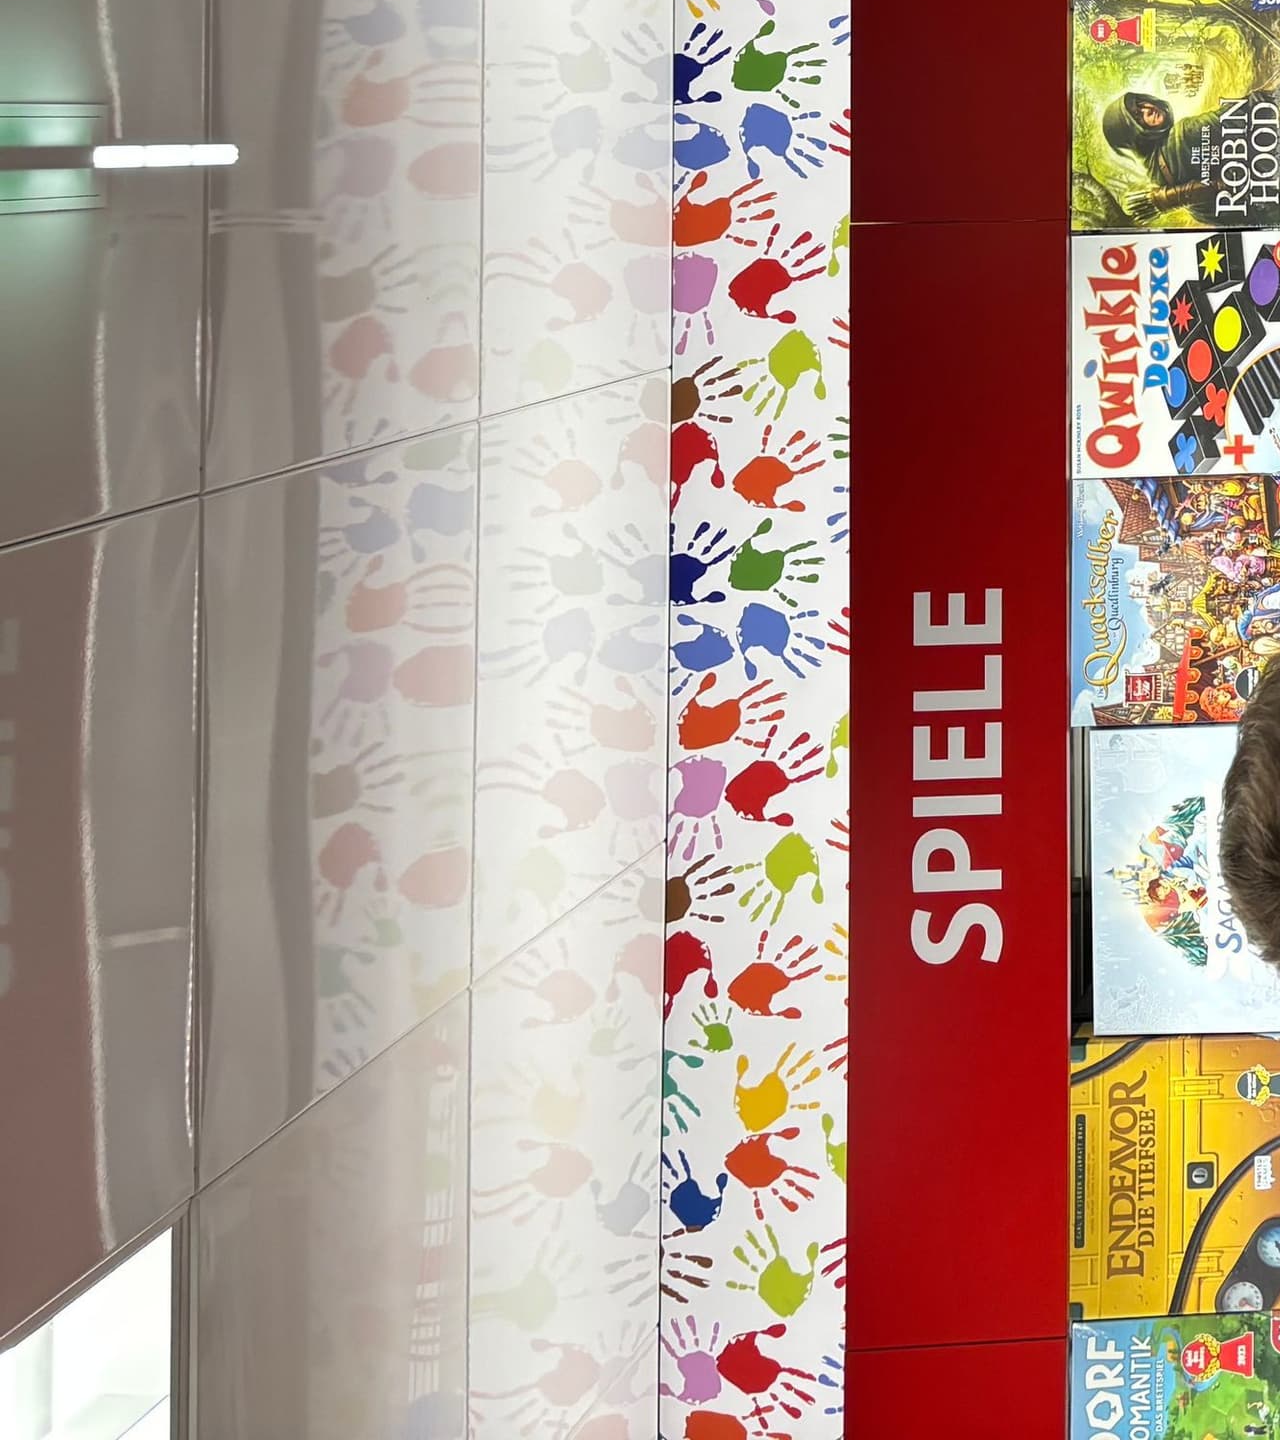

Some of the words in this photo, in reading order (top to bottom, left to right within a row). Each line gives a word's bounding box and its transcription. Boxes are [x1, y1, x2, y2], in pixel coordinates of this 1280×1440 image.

[1191, 147, 1200, 164] DIE
[1201, 125, 1210, 186] ABENTEUER
[1211, 146, 1220, 165] DES
[1215, 97, 1250, 216] ROBIN
[1251, 102, 1280, 205] HOOD
[1082, 243, 1143, 468] Qwirkle
[1142, 246, 1171, 395] Deluxe
[1081, 510, 1126, 699] Quacksalber
[1108, 558, 1123, 630] Quedlinburg
[910, 588, 1003, 965] SPIELE
[1107, 1071, 1146, 1278] ENDEAVOR
[1138, 1109, 1155, 1200] TIEFSEE
[1138, 1207, 1154, 1246] DIE
[1156, 1359, 1164, 1411] BRETTSPIEL
